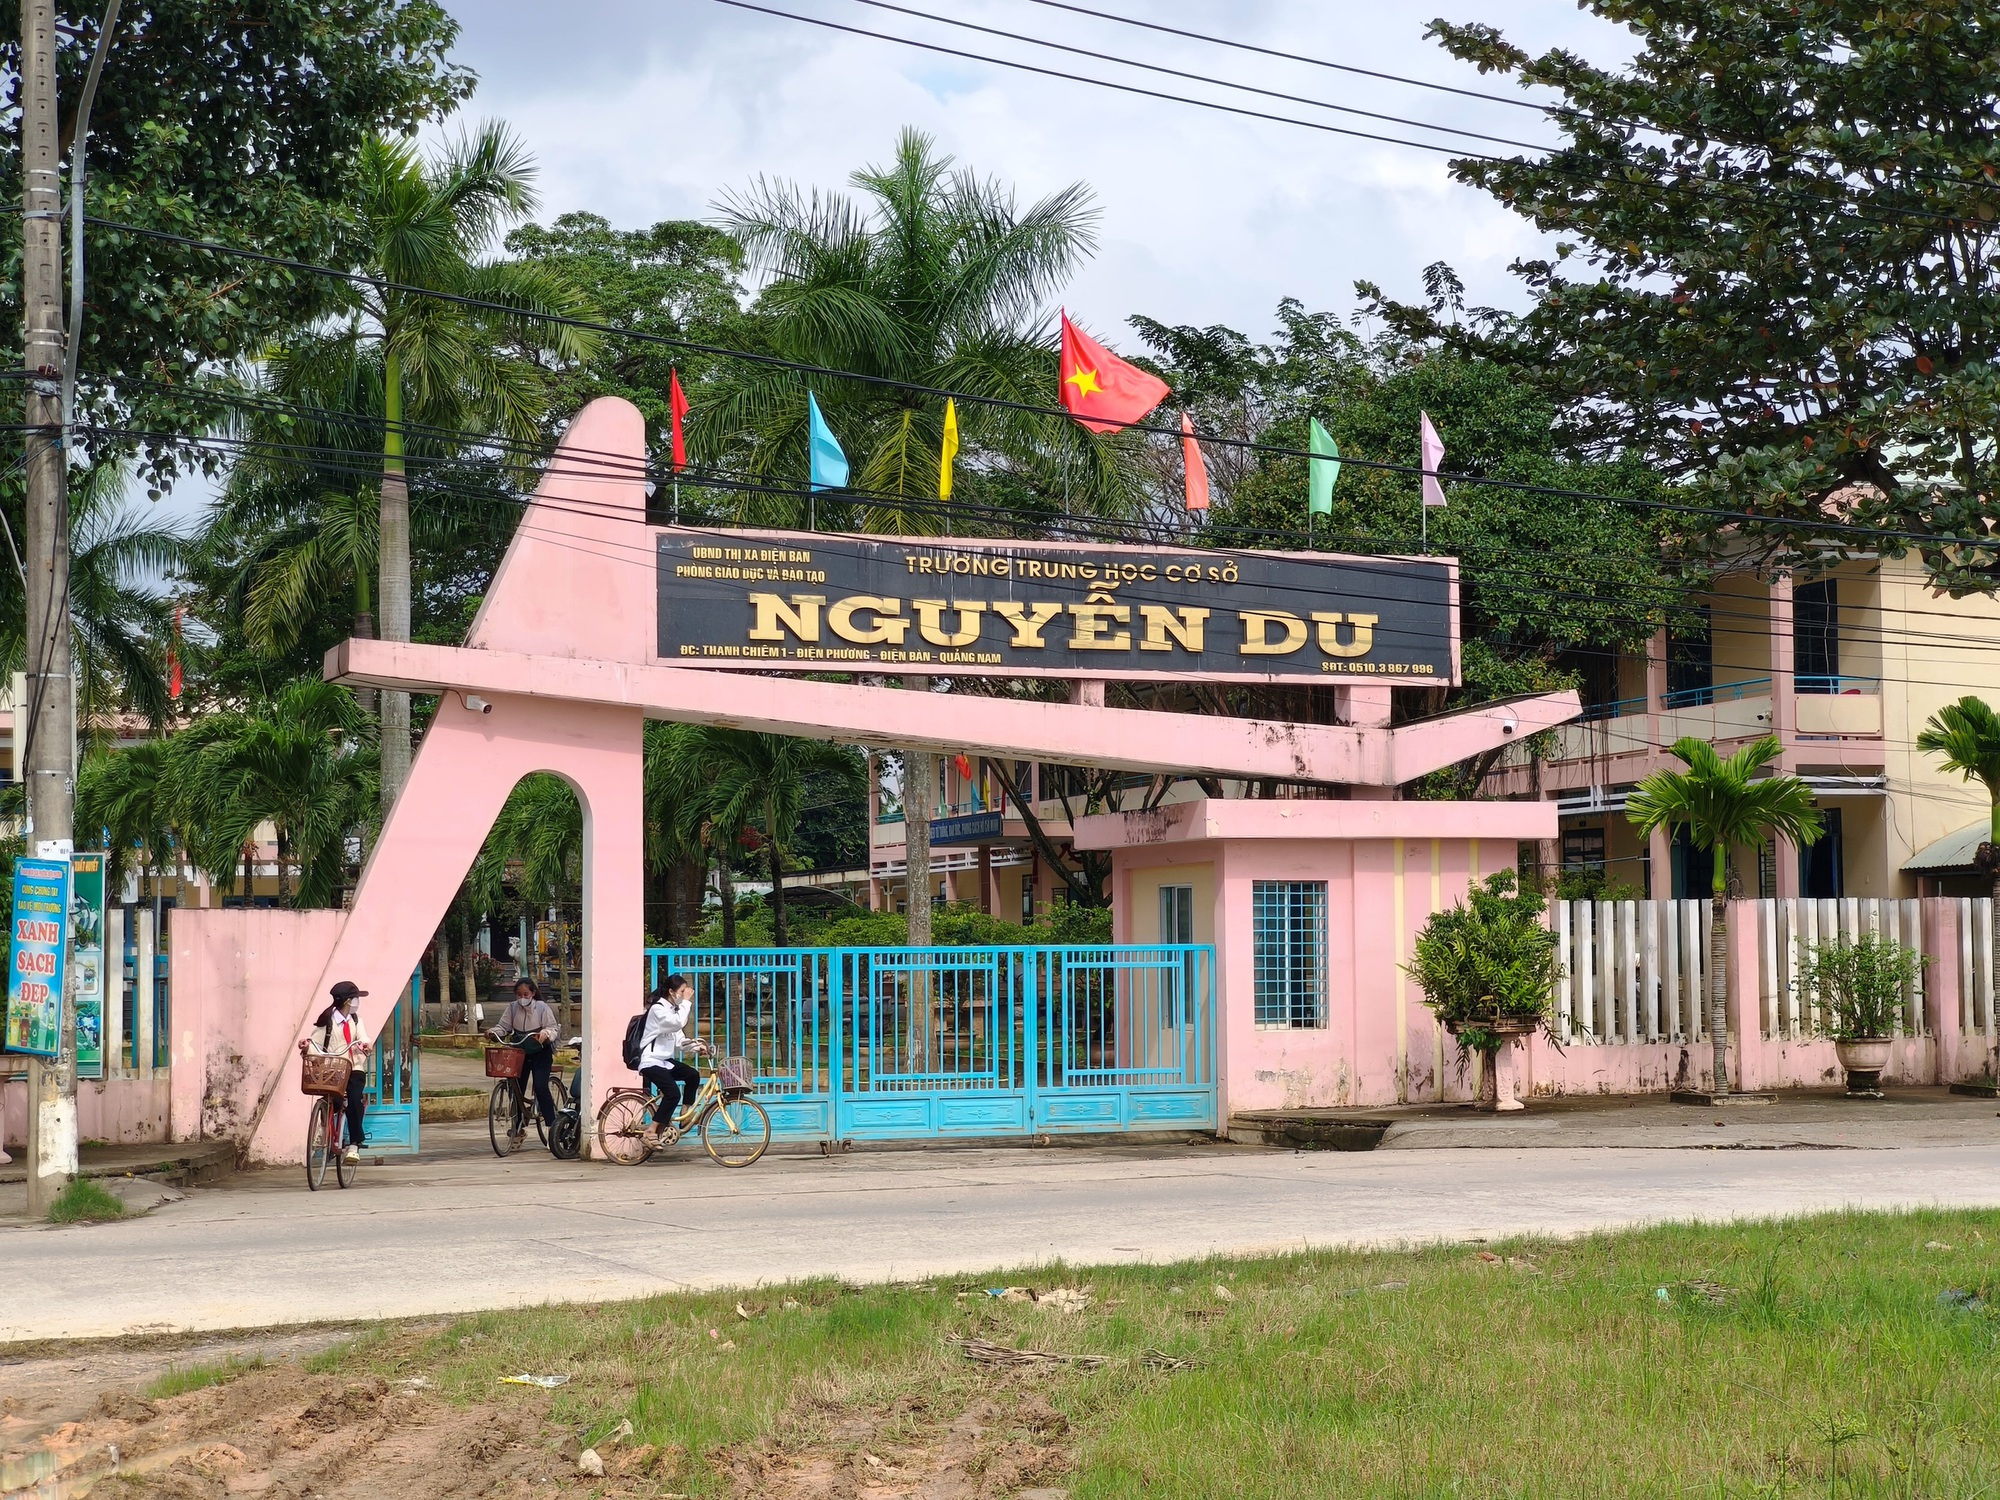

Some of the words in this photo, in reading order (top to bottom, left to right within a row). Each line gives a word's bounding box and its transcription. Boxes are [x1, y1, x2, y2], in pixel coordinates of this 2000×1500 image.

[693, 547, 722, 559] UBND
[724, 549, 742, 564] THỊ
[761, 548, 787, 565] ĐIỆN
[676, 563, 713, 578] PHÒNG
[715, 564, 740, 579] GIÁO
[742, 567, 764, 583] DỤC
[766, 566, 780, 581] VÀ
[782, 567, 804, 581] ĐÀO
[806, 570, 825, 585] TẠO
[1015, 559, 1098, 579] TRUNG
[1104, 563, 1157, 586] HỌC
[1165, 563, 1201, 583] CƠ
[1207, 559, 1239, 584] SỞ
[747, 581, 1211, 653] NGUYỄN
[1238, 609, 1379, 657] DU
[680, 645, 700, 655] ĐC:
[702, 645, 740, 656] THANH
[742, 645, 779, 657] CHIÊM
[796, 646, 824, 661] ĐIỆN
[826, 648, 870, 660] PHƯƠNG
[880, 649, 906, 664] ĐIỆN
[909, 649, 930, 662] BÀN
[939, 649, 975, 663] QUẢNG
[977, 653, 1001, 663] NAM
[1388, 663, 1410, 673] 867
[1412, 664, 1434, 674] 996
[17, 920, 59, 943] XANH
[17, 951, 56, 976] SẠCH
[21, 982, 49, 1008] ĐẸP
